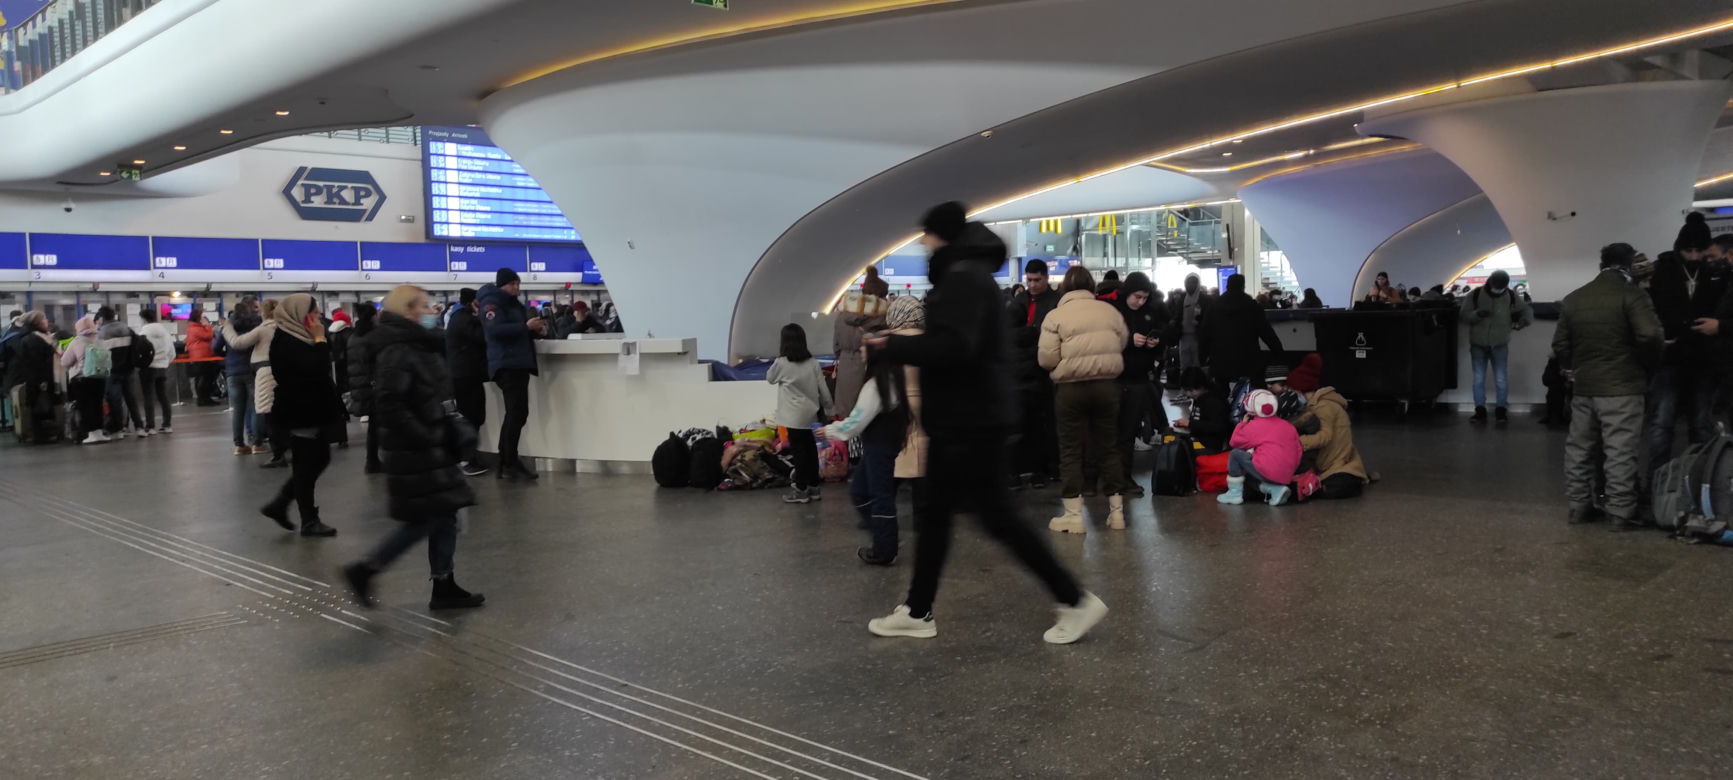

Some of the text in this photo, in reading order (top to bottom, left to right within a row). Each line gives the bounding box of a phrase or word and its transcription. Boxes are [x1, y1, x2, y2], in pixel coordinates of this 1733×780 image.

[300, 182, 373, 206] PKP
[34, 272, 41, 280] 3
[158, 271, 165, 279] 4
[267, 272, 273, 280] 5
[453, 273, 458, 281] 7
